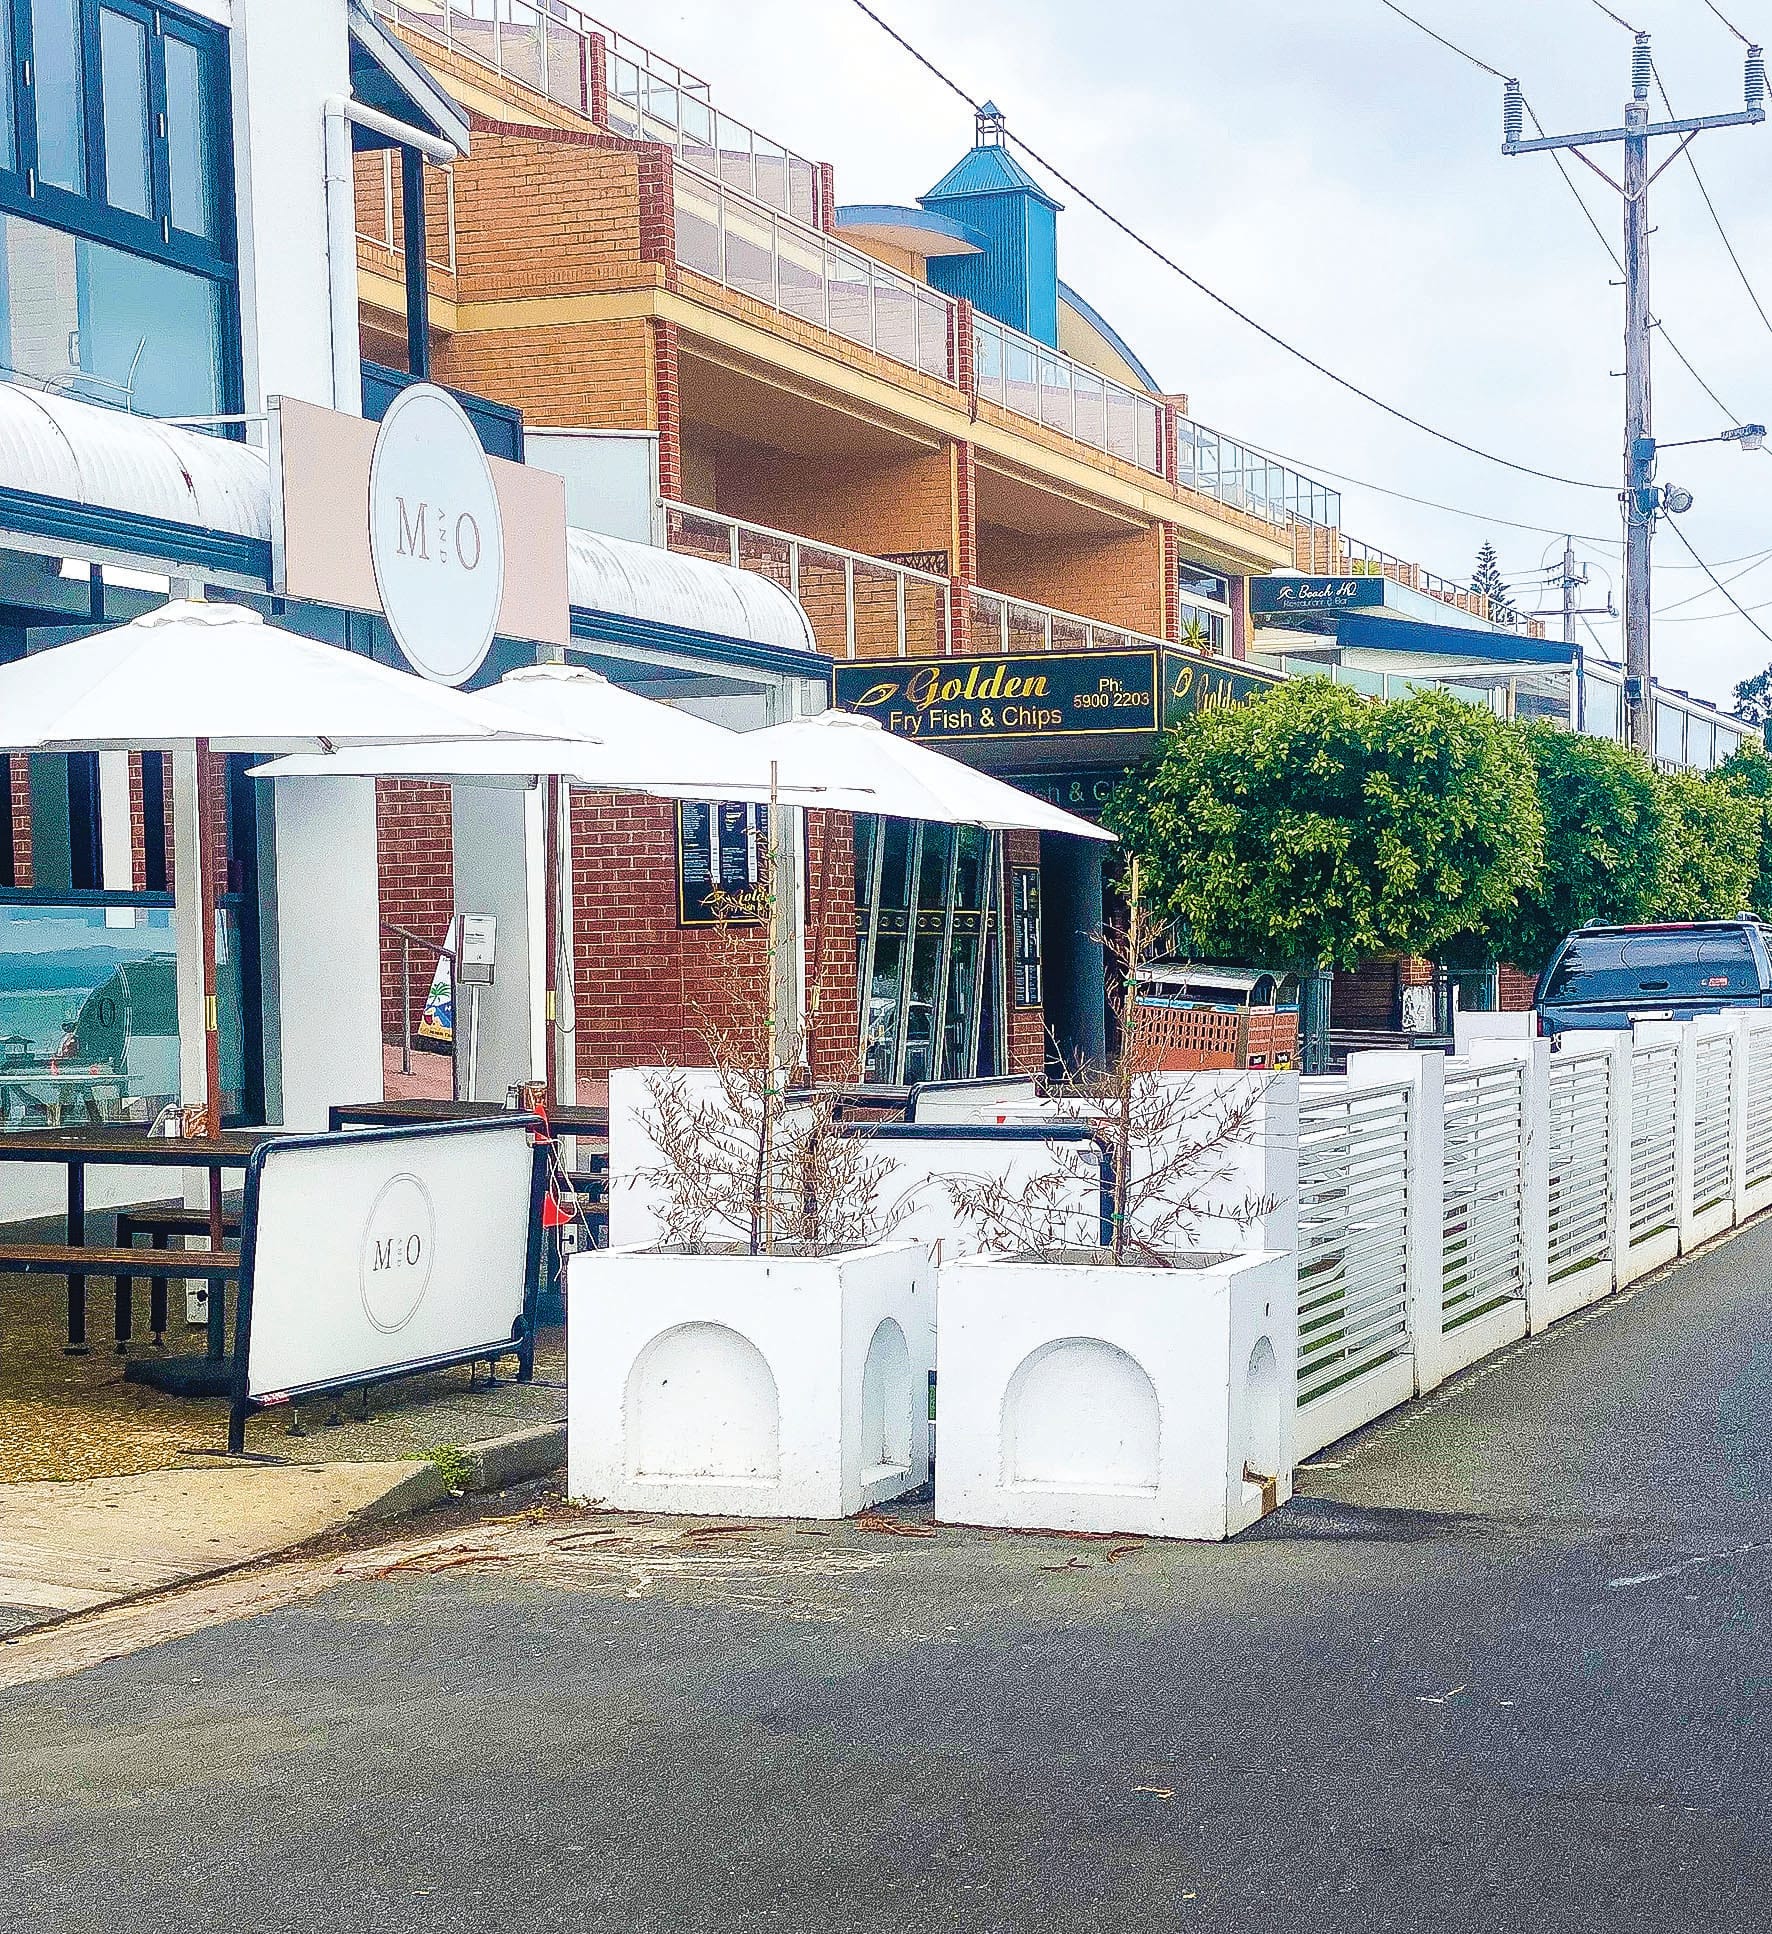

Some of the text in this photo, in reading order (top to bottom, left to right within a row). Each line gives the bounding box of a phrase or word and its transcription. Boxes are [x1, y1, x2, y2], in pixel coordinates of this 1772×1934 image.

[395, 496, 430, 561] M
[455, 512, 481, 570] O
[1298, 581, 1357, 599] Beach HQ
[903, 664, 1050, 712] Golden
[1072, 691, 1150, 709] 5900 2203
[1098, 677, 1124, 693] Ph:
[889, 705, 1063, 735] Fry Fish & Chips
[372, 1238, 395, 1272] M
[406, 1234, 421, 1266] O
